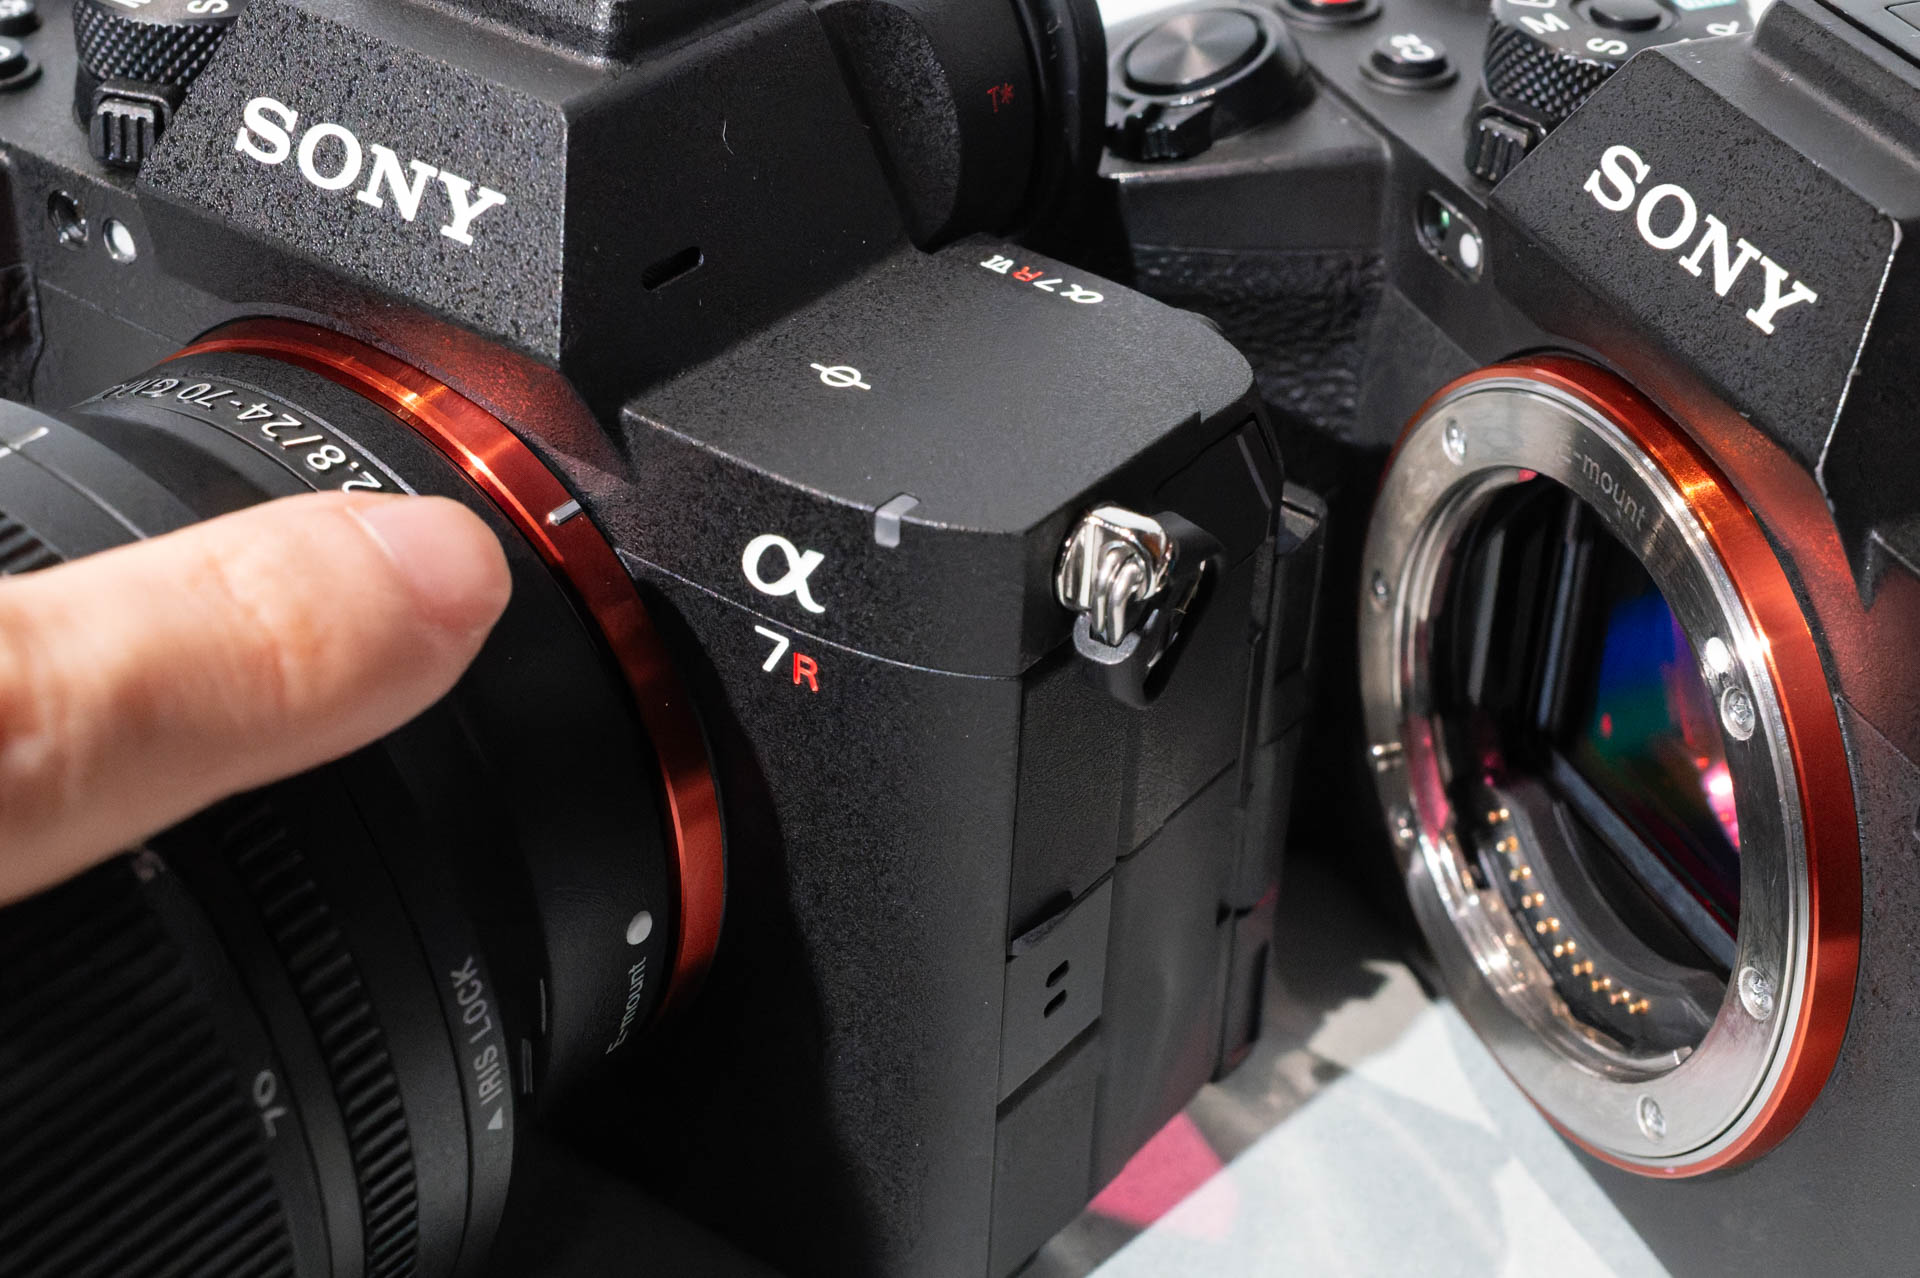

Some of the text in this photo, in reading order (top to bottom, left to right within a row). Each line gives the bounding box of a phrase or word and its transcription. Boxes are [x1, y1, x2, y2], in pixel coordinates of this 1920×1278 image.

[1519, 12, 1570, 35] M
[1586, 37, 1629, 56] S
[235, 97, 506, 245] SONY
[1583, 145, 1818, 335] SONY
[754, 625, 819, 692] 7R
[450, 956, 503, 1107] IRIS LOCK
[605, 956, 647, 1055] E-mount
[254, 1069, 288, 1138] 70
